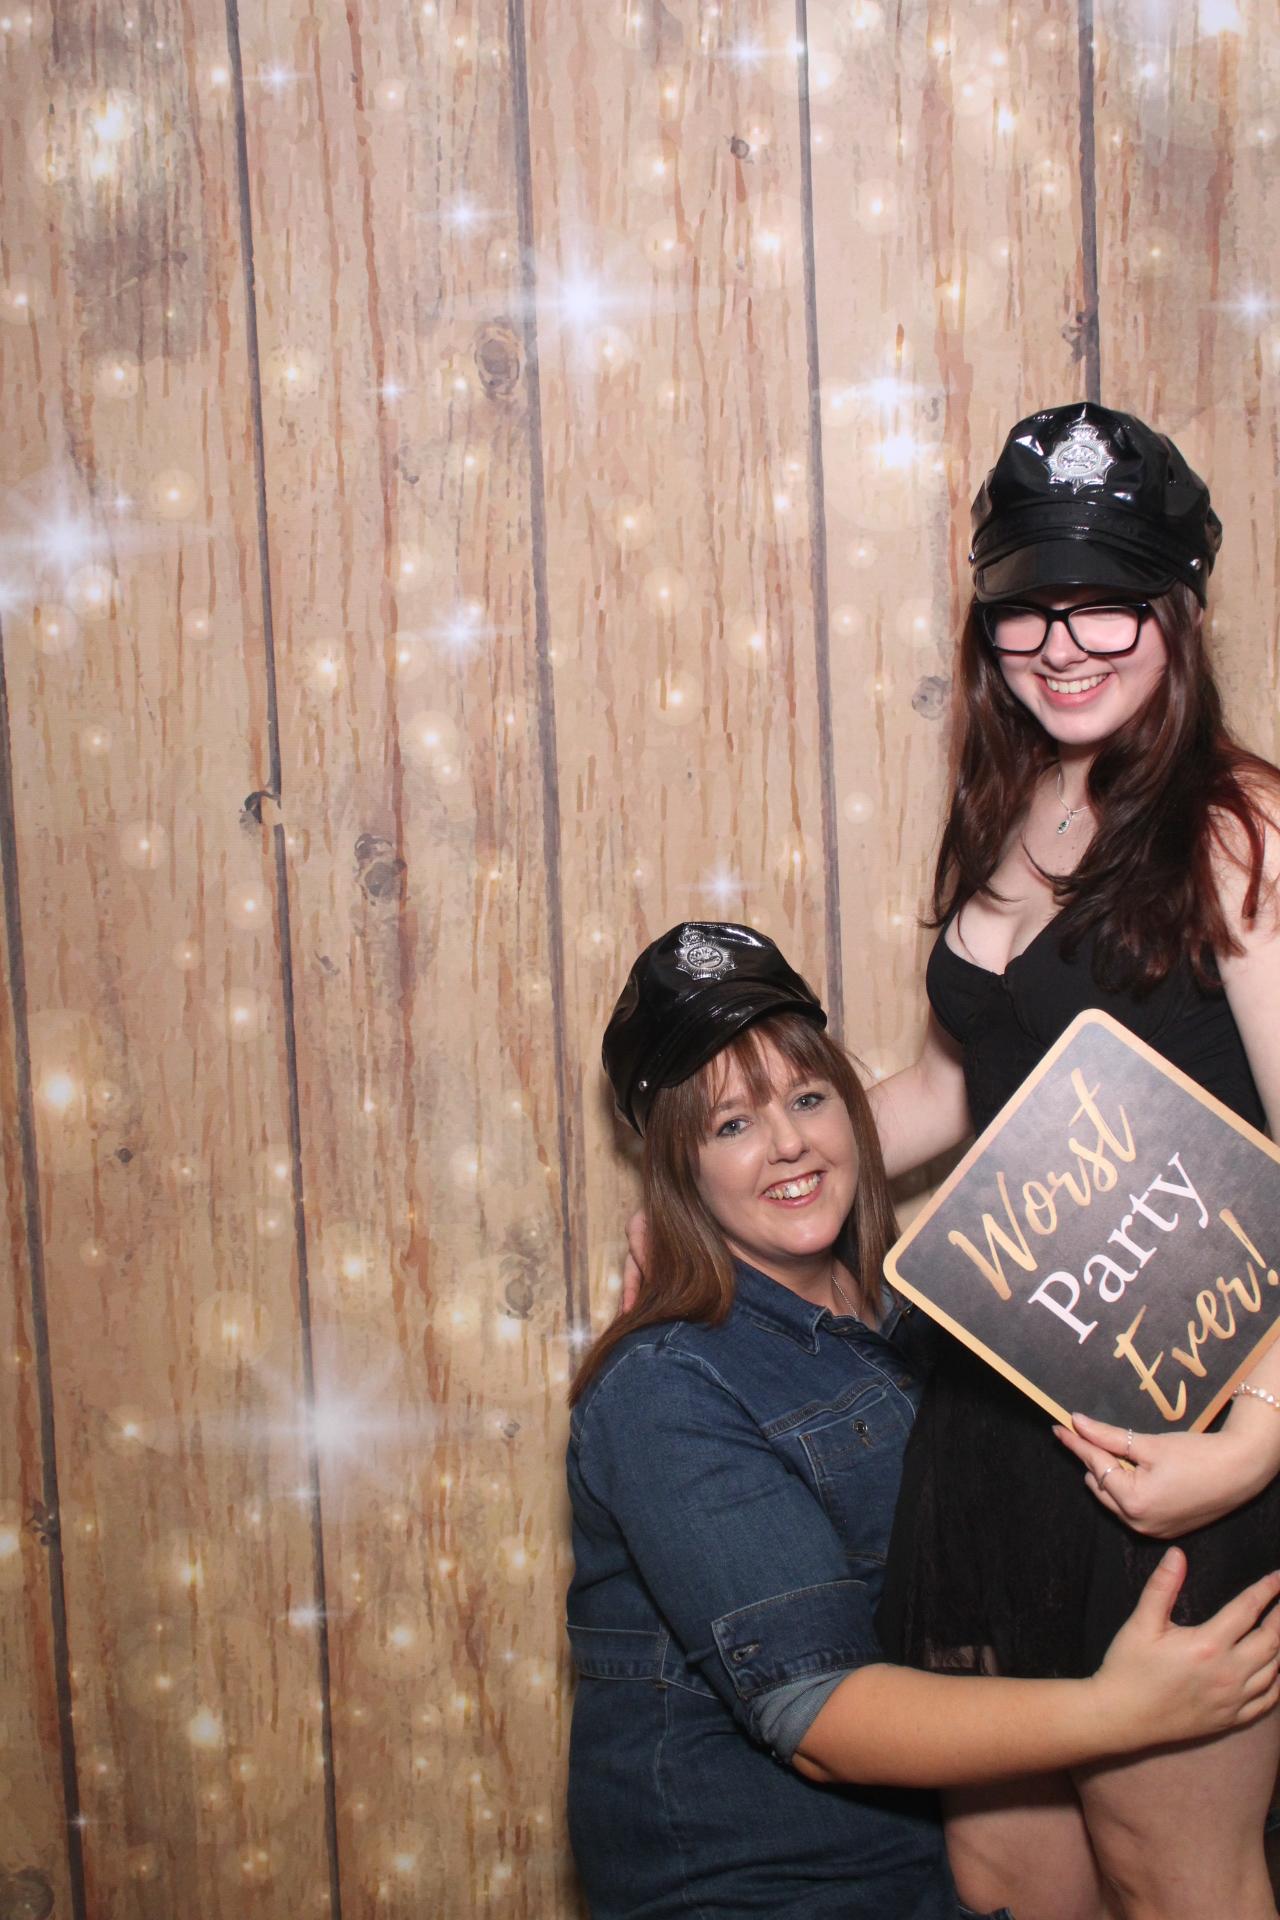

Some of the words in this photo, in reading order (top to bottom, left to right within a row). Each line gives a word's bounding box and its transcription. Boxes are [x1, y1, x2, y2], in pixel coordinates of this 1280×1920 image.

[947, 1067, 1137, 1300] Worst
[1028, 1152, 1210, 1345] Party
[1113, 1208, 1279, 1421] Ever!
